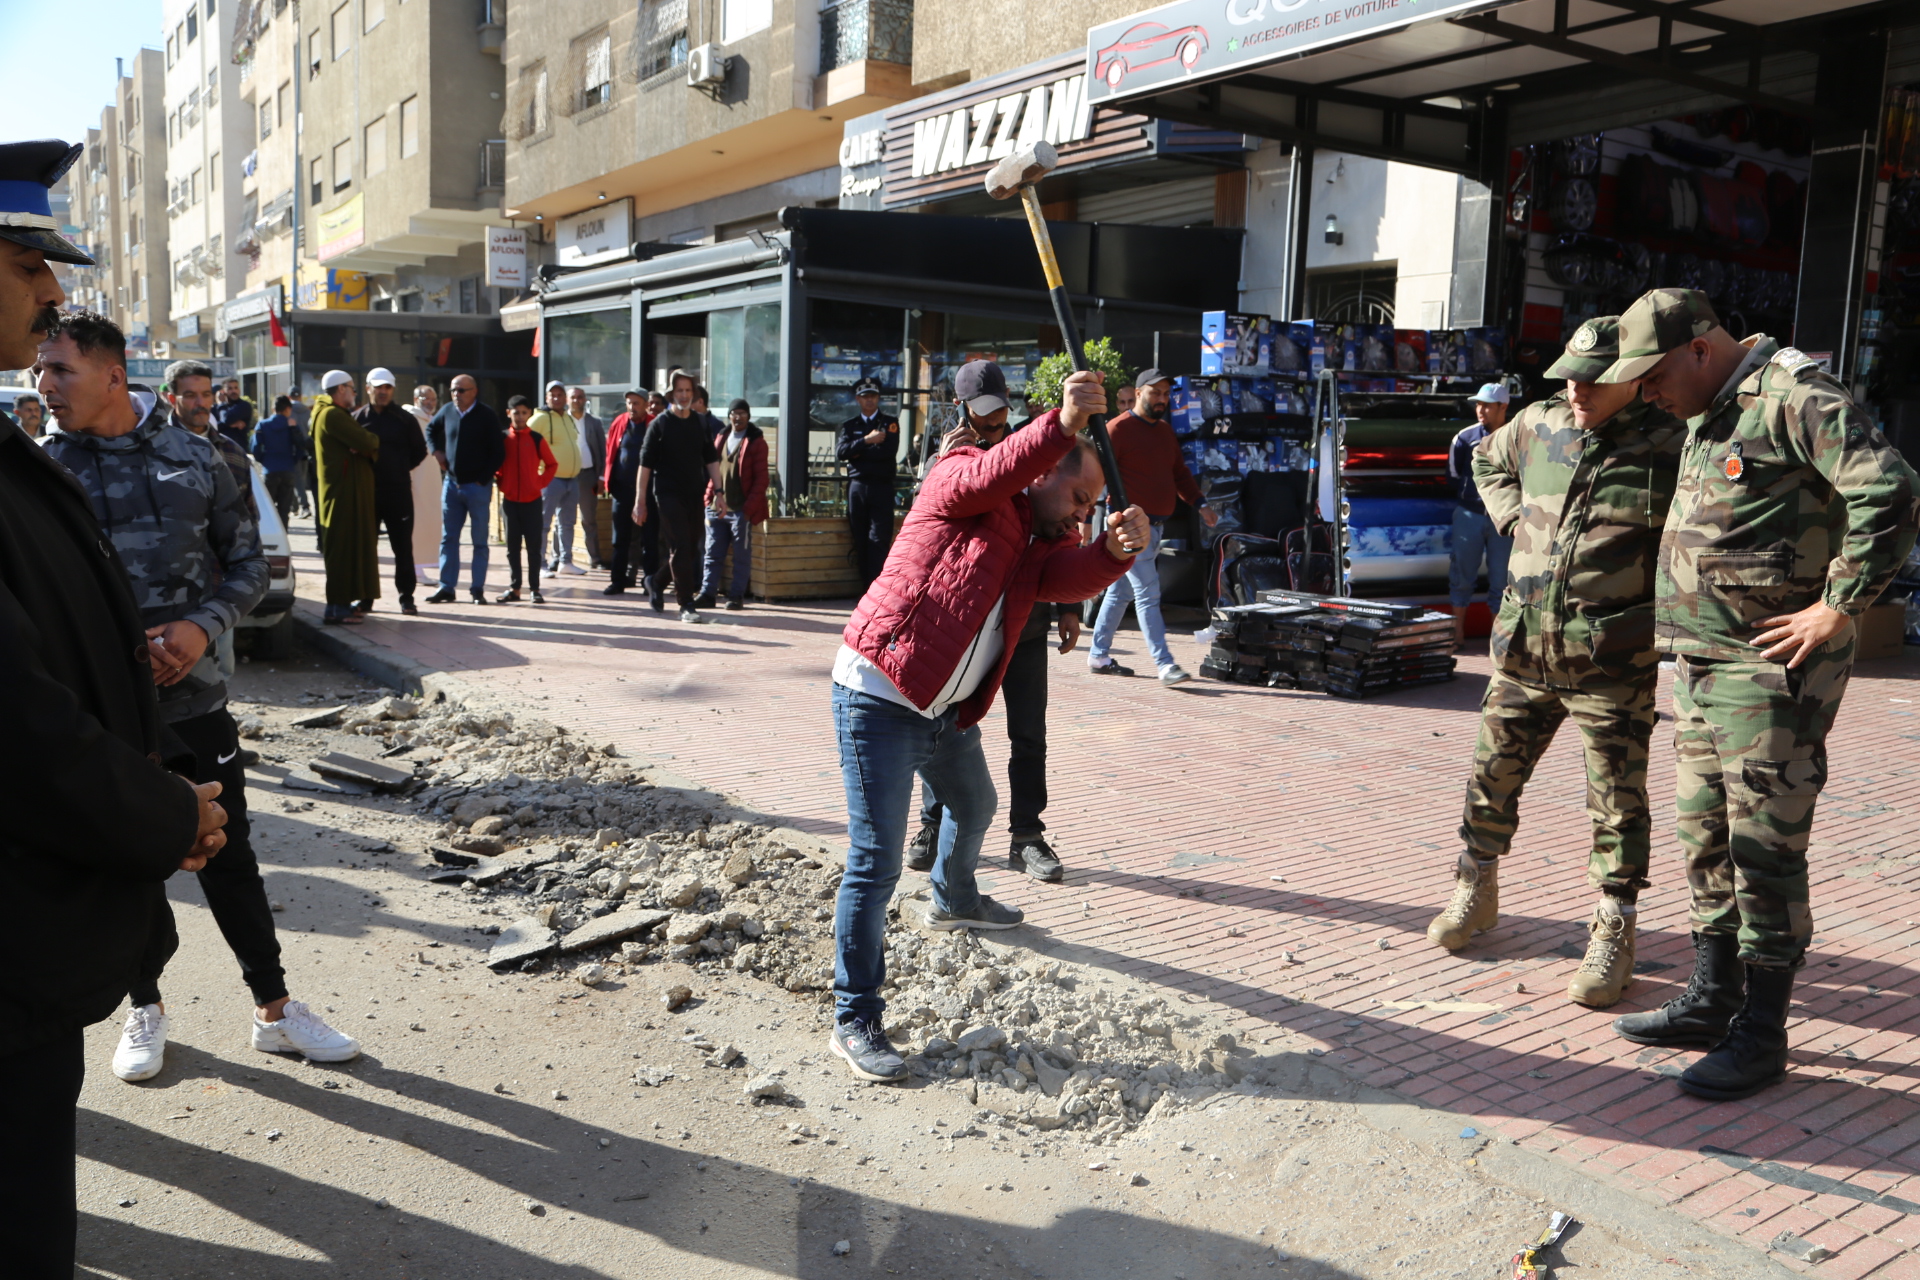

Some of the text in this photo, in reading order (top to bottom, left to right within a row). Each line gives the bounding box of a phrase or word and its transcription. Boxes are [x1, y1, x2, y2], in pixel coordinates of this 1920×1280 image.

[1242, 17, 1320, 48] ACCESSOIRES
[1325, 10, 1342, 26] DE
[1345, 0, 1399, 21] VOITURE
[912, 73, 1094, 178] WAZZANI
[839, 129, 882, 168] CAFE
[576, 218, 605, 241] AFLOUN
[491, 245, 525, 255] AFLOUN
[1320, 602, 1348, 611] MASTERPIECE
[1363, 608, 1392, 616] ACCESSORIES
